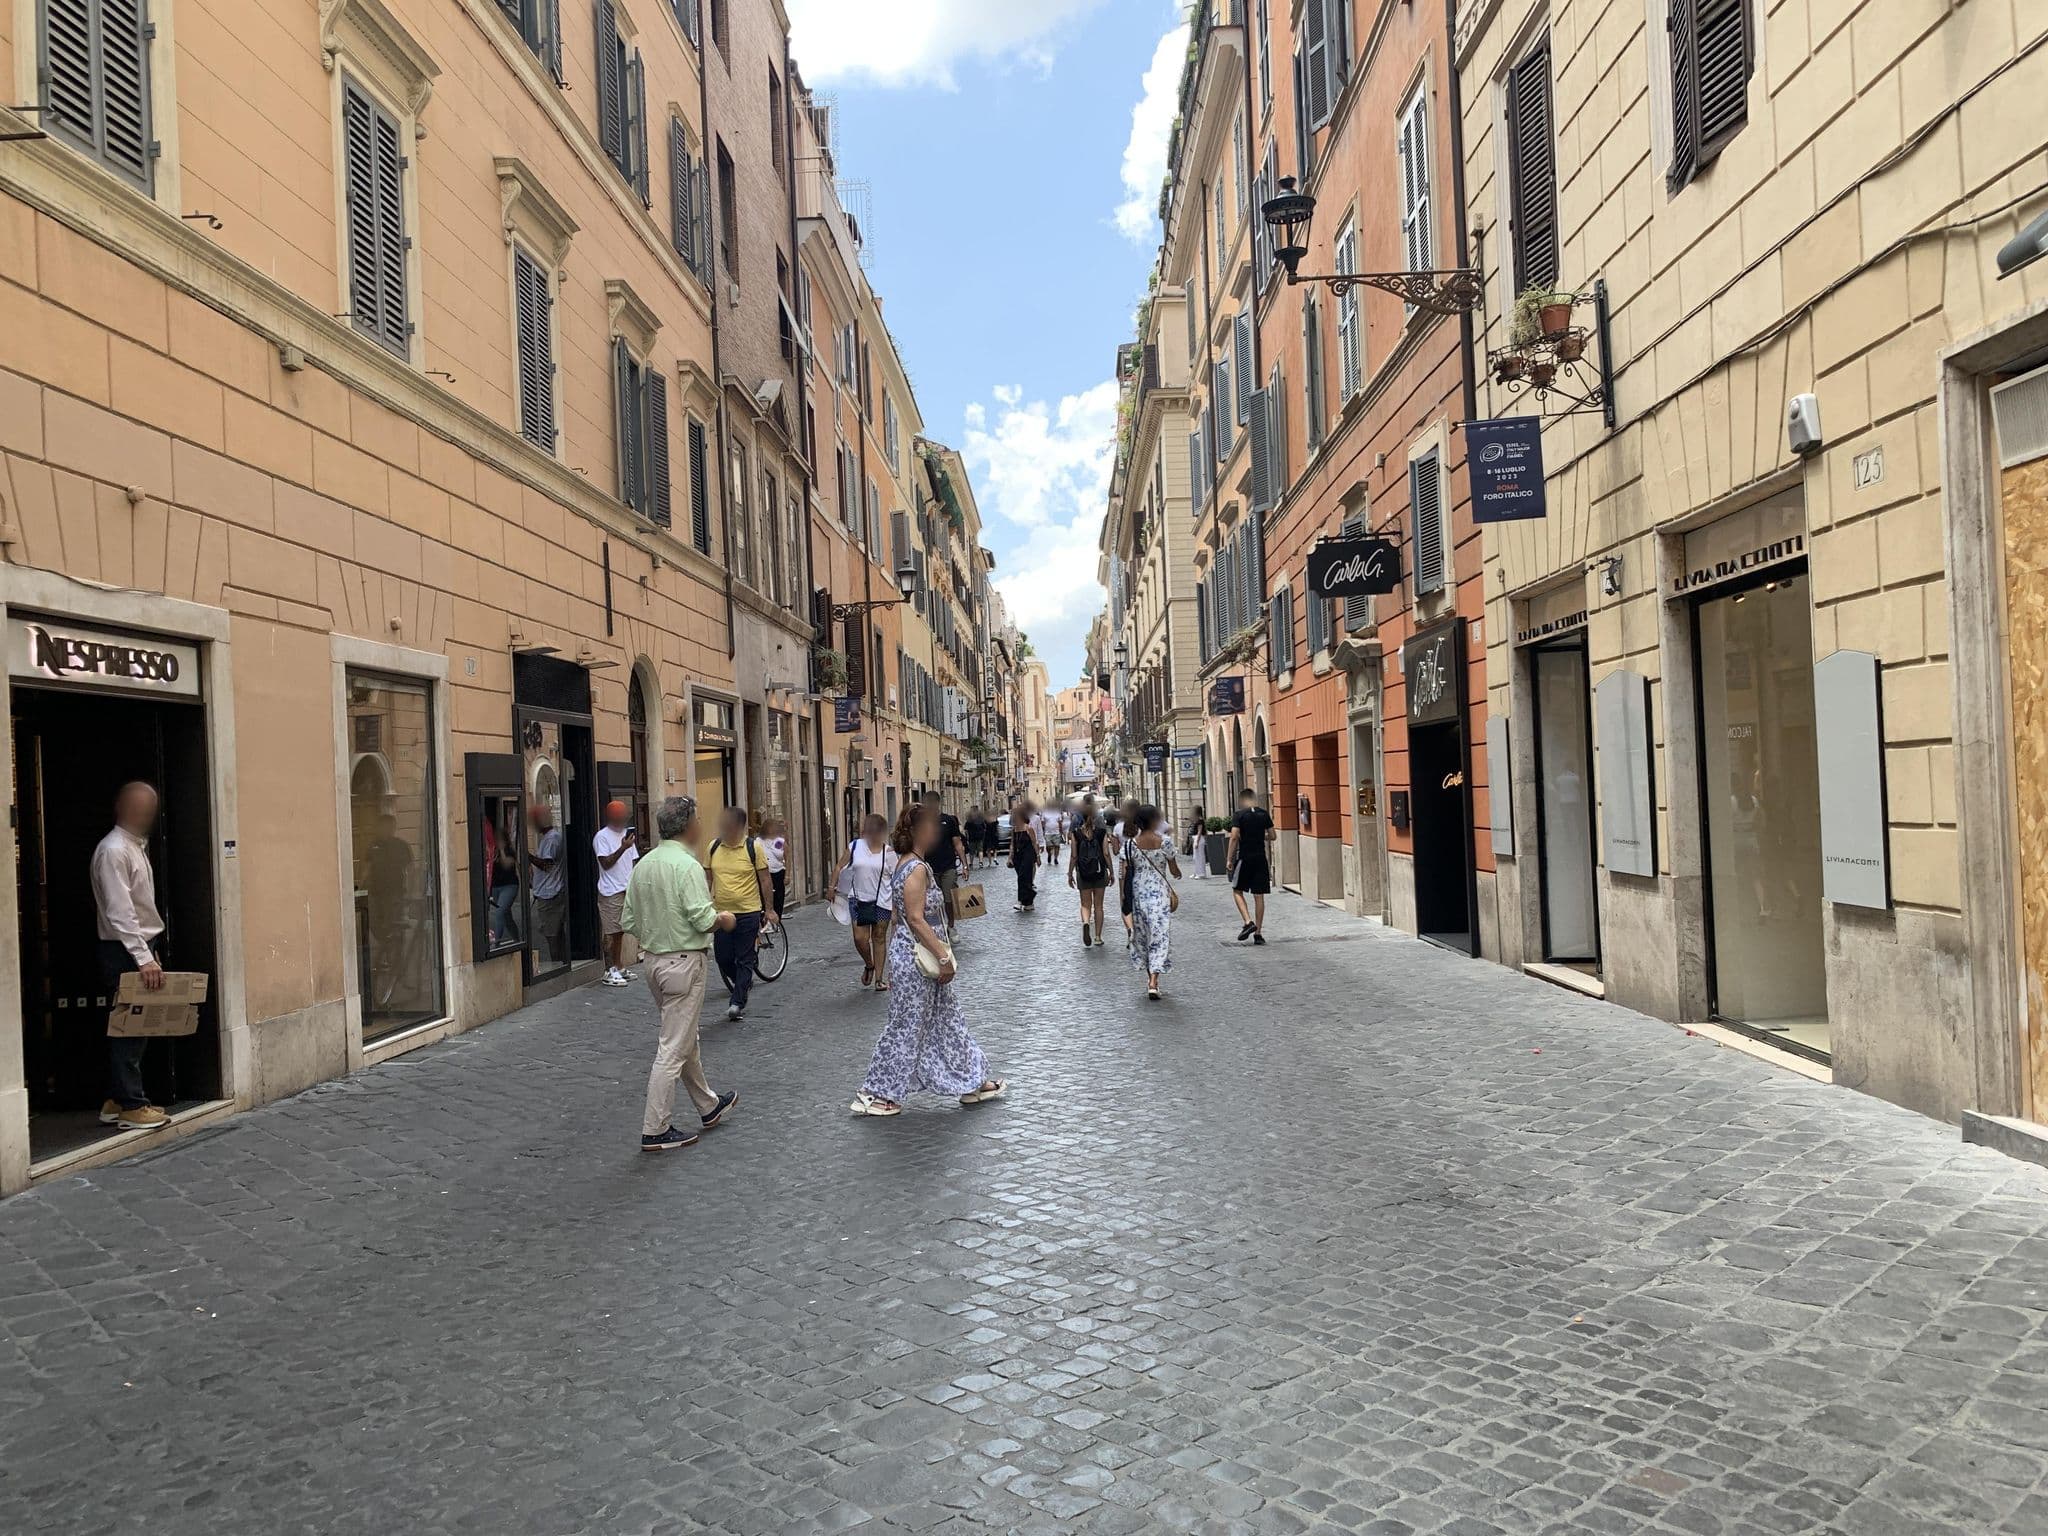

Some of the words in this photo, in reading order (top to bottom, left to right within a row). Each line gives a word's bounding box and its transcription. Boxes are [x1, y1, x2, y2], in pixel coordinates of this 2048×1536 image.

[1501, 466, 1526, 474] LUGLIO
[1856, 453, 1881, 487] 125
[1496, 483, 1519, 492] ROMA
[1505, 490, 1533, 499] ITALICO
[24, 625, 179, 682] NESPRESSO
